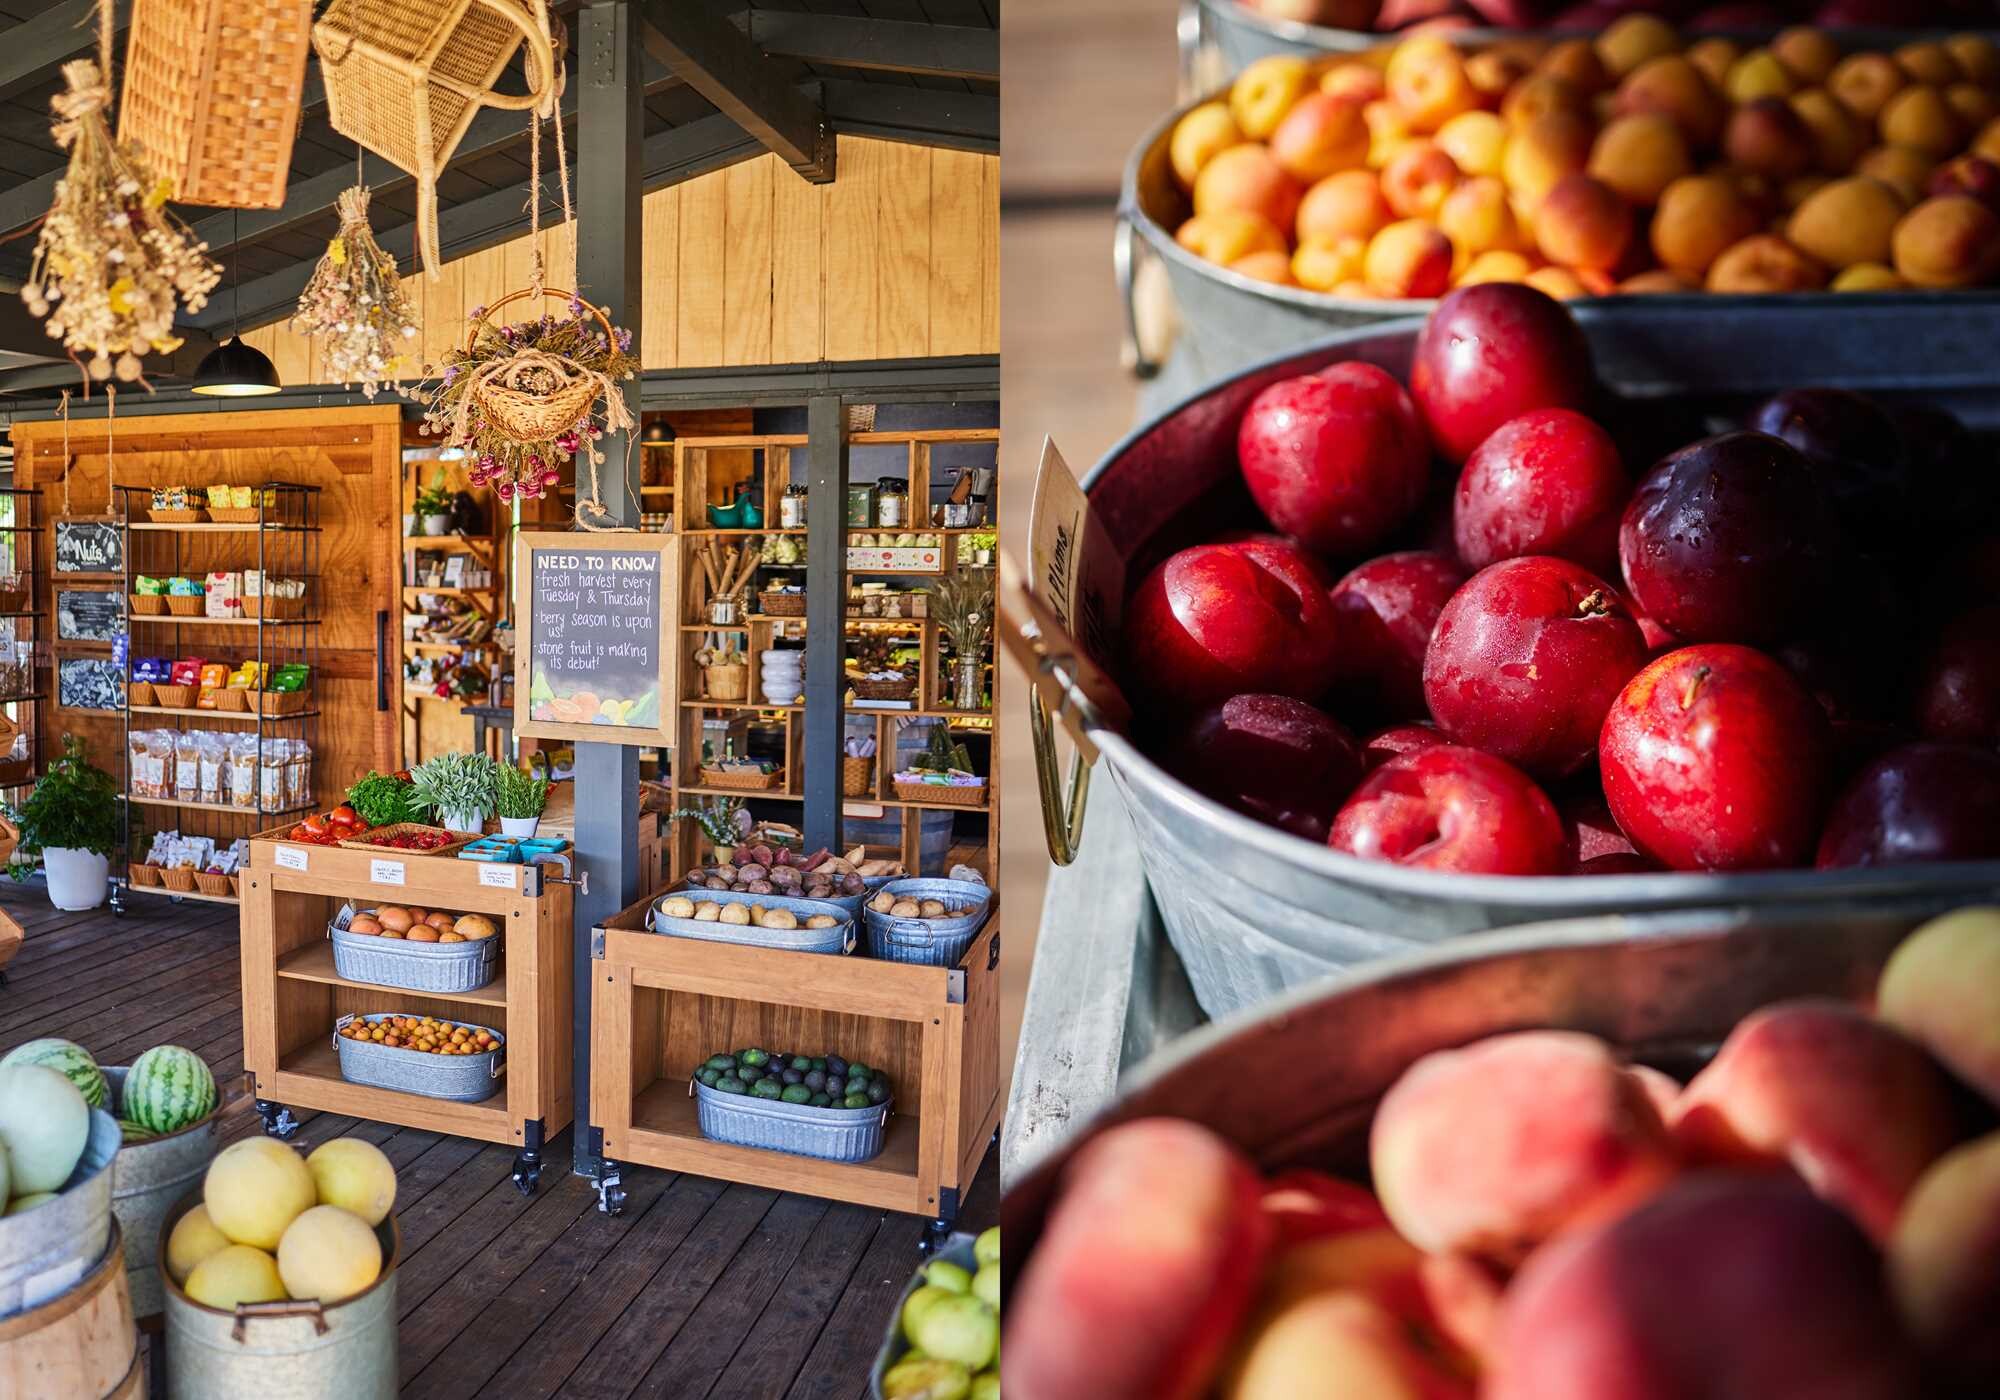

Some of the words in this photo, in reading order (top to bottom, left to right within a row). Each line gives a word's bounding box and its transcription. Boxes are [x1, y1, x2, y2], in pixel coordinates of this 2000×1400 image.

[75, 539, 103, 562] Nuts
[538, 556, 579, 569] NEED
[585, 557, 604, 570] TO
[612, 557, 656, 571] KNOW
[1048, 525, 1067, 603] Plums
[541, 571, 570, 587] fresh
[579, 572, 616, 588] harvest
[623, 576, 652, 595] every
[540, 588, 580, 610] Tuesday
[587, 589, 597, 604] &
[600, 590, 651, 614] Thursday
[540, 610, 565, 625] berry
[572, 613, 607, 627] season
[612, 616, 620, 627] is
[625, 616, 652, 634] upon
[548, 625, 563, 638] us!
[538, 641, 564, 655] stone
[570, 640, 592, 654] fruit
[596, 643, 604, 656] is
[550, 655, 562, 669] its
[567, 656, 600, 670] debut!
